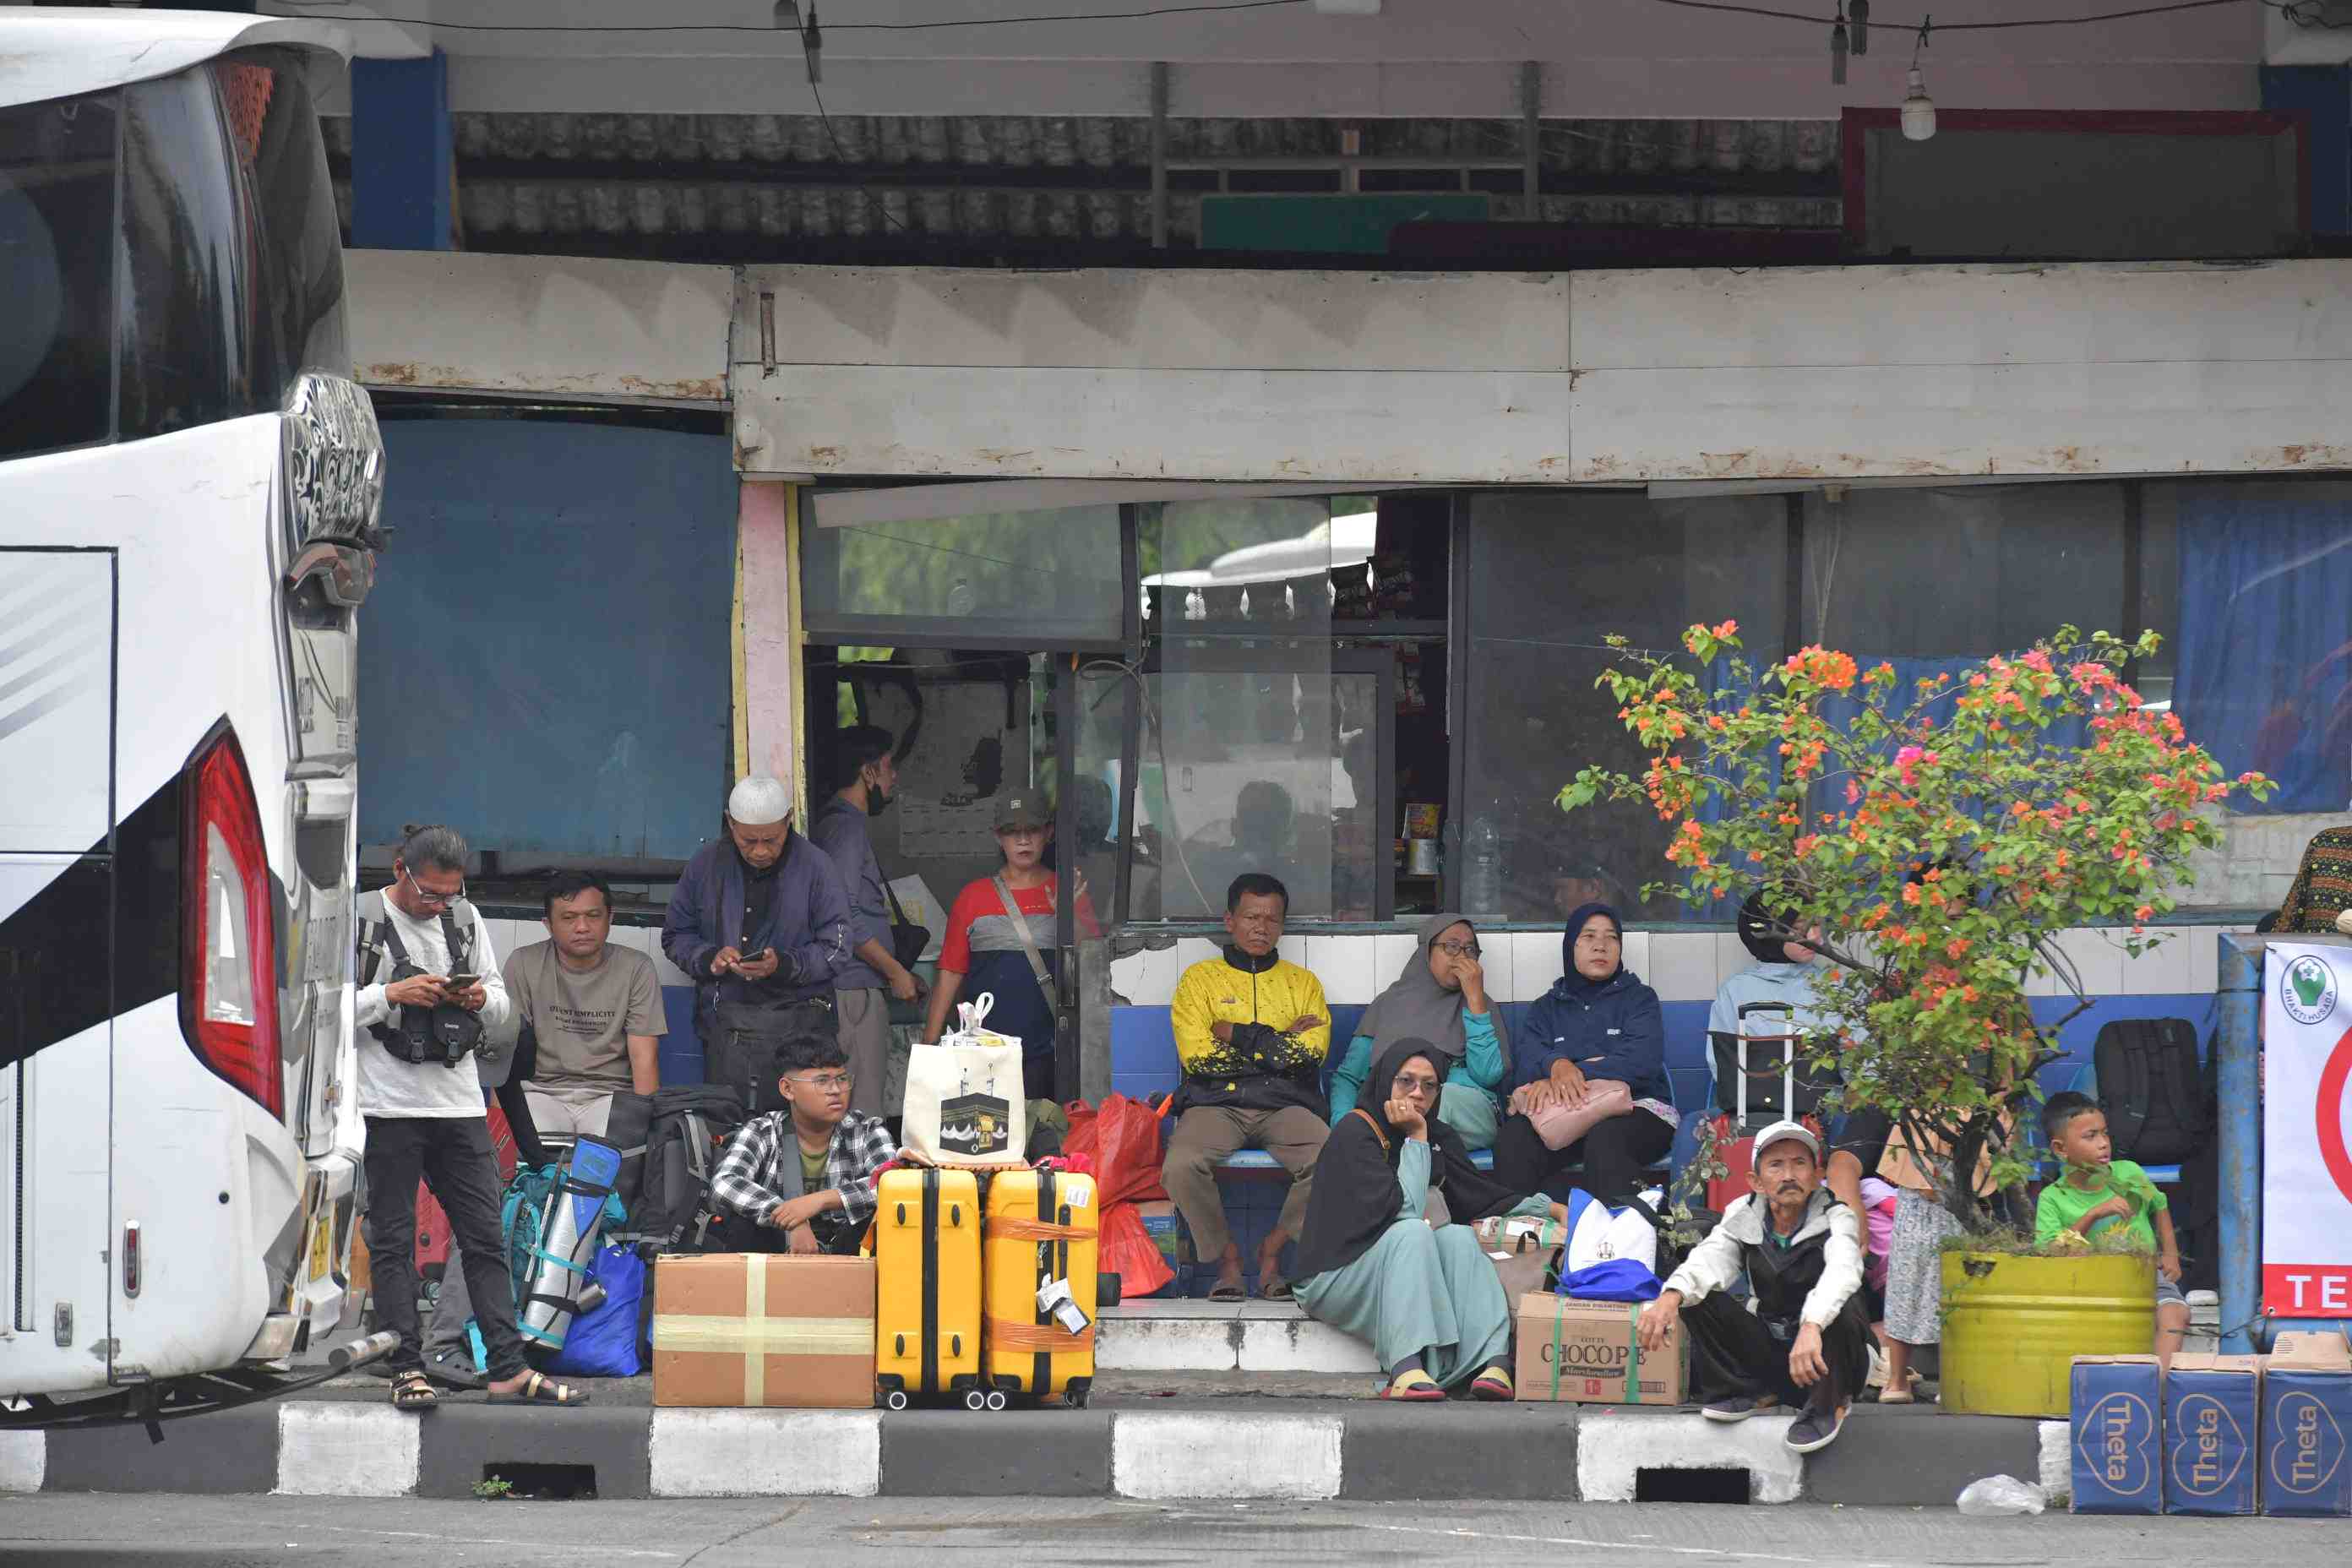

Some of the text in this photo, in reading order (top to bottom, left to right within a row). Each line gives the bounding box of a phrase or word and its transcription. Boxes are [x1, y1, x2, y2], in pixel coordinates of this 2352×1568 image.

[2107, 1400, 2131, 1481] Theta
[2193, 1408, 2218, 1488] Theta
[2292, 1406, 2317, 1485] Theta
